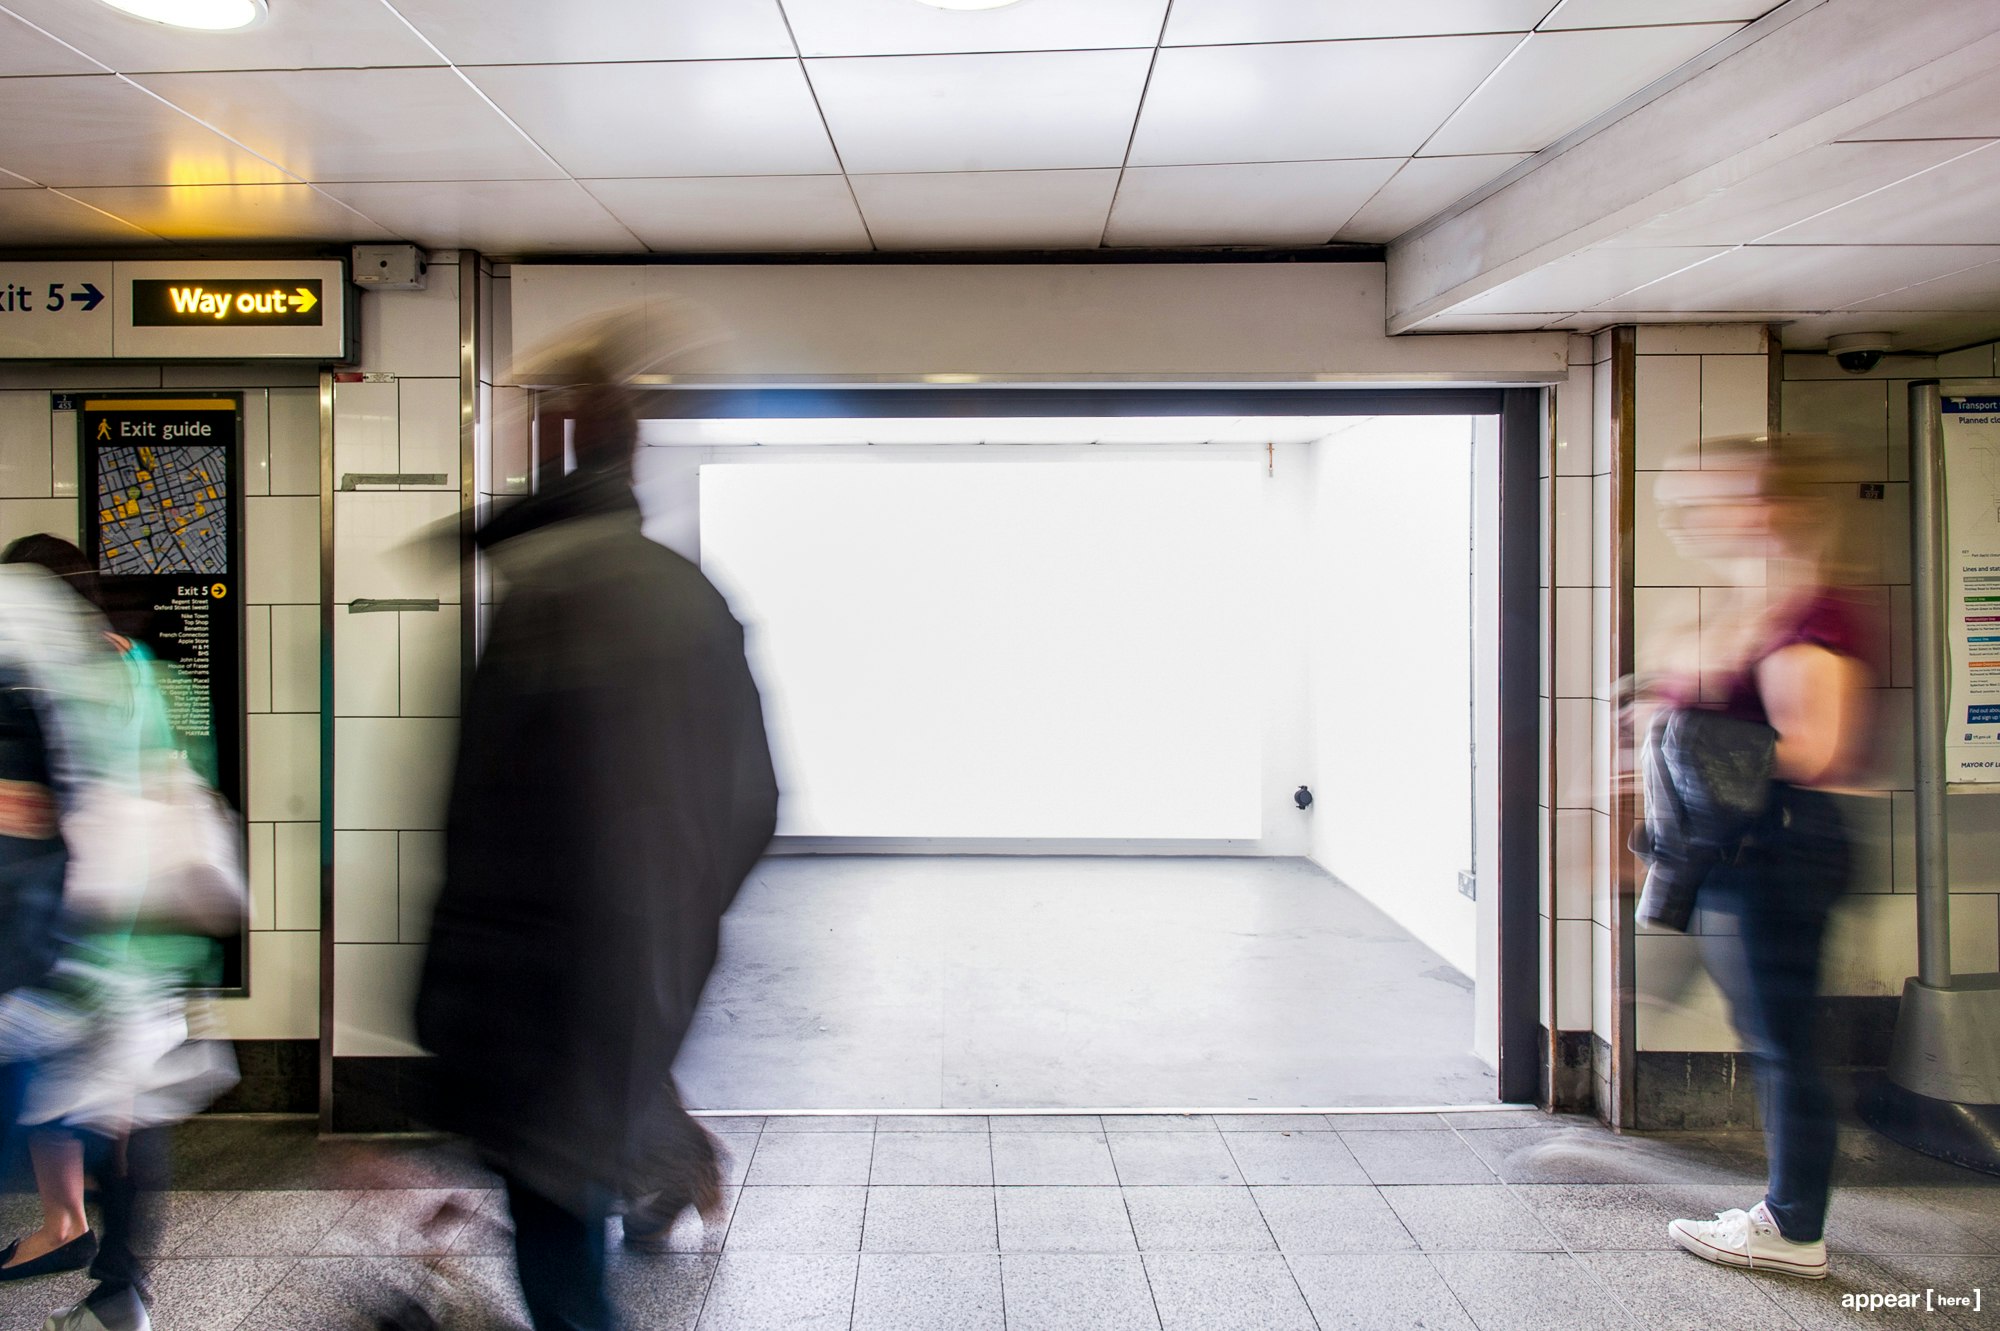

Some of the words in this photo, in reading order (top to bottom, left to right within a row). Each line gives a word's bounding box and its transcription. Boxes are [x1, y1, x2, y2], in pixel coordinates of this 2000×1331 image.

[46, 283, 64, 312] 5
[169, 287, 232, 319] Way
[236, 289, 288, 313] out
[1958, 401, 1998, 411] Transport
[1959, 416, 1988, 424] Planned
[121, 421, 156, 437] Exit
[162, 421, 211, 440] guide
[177, 586, 199, 596] Exit
[201, 586, 209, 596] 5
